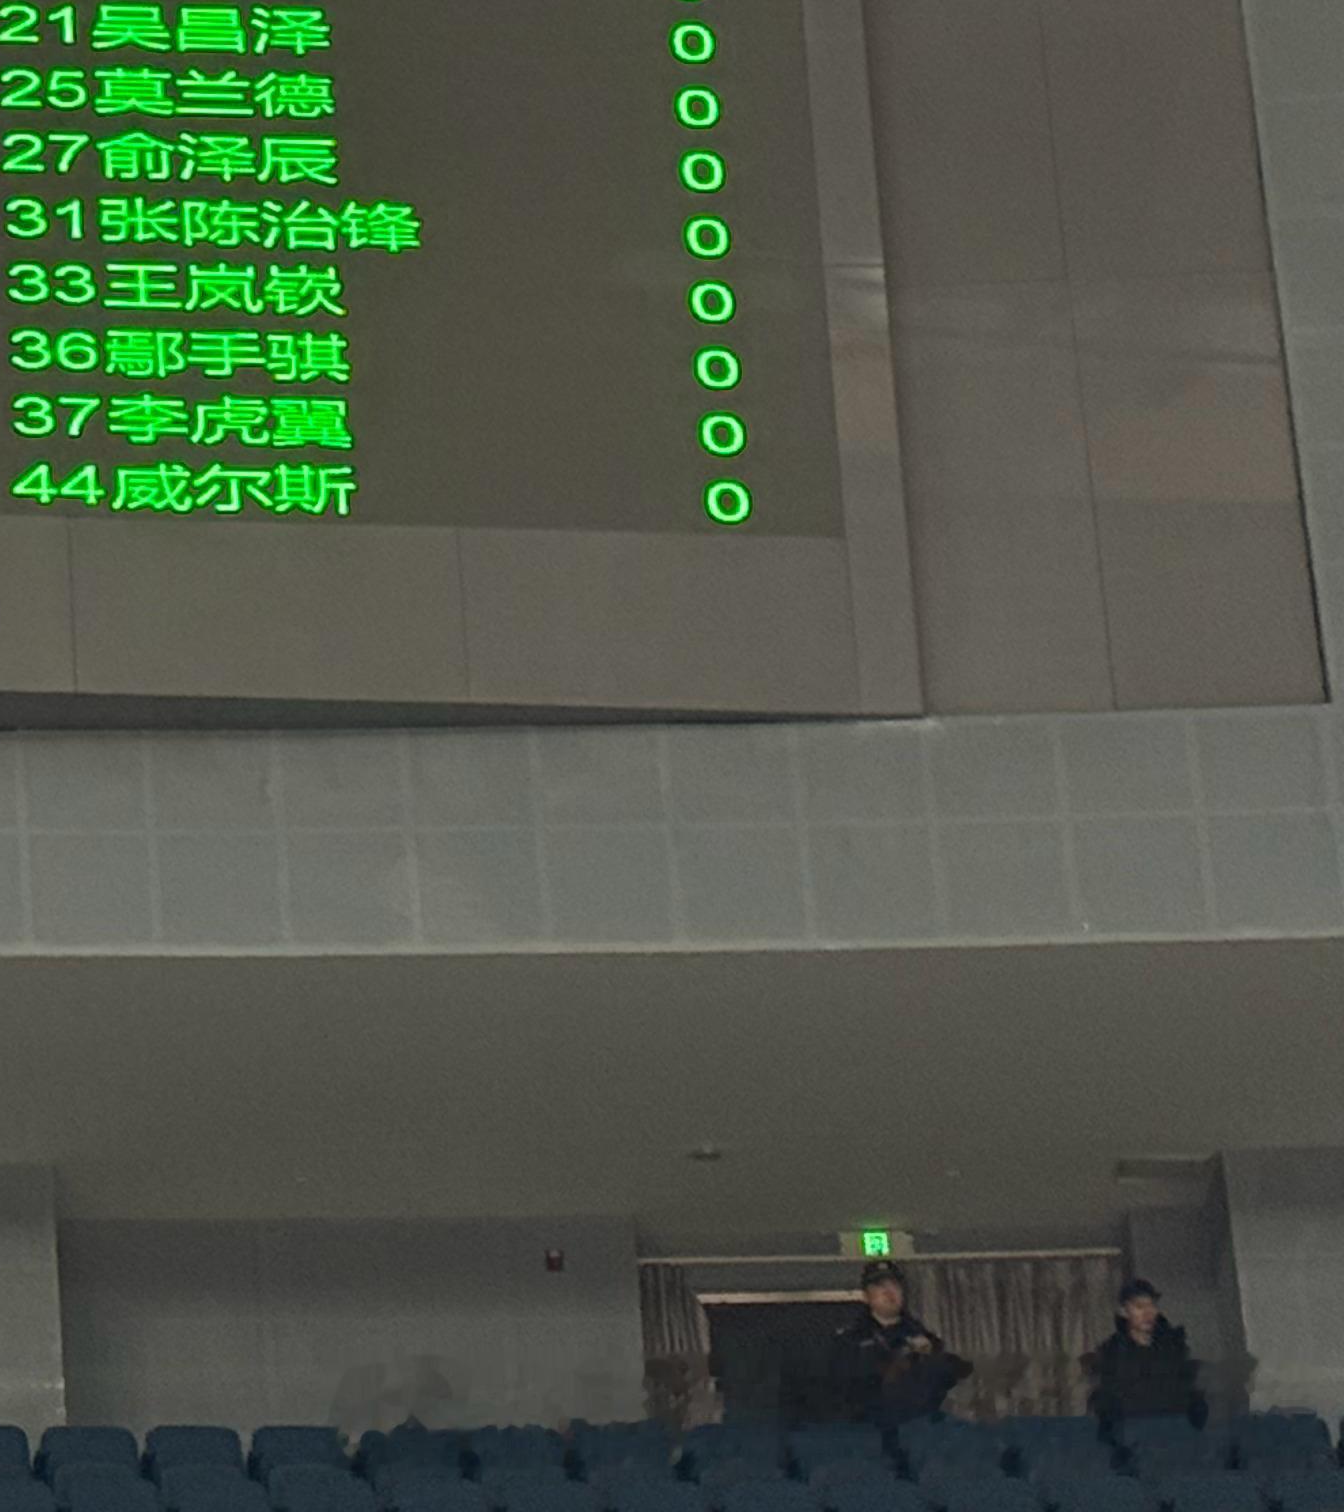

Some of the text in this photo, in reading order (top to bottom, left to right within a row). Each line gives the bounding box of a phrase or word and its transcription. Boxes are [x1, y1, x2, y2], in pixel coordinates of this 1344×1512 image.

[670, 21, 715, 63] 0
[674, 86, 720, 128] 0
[679, 149, 724, 192] 0
[683, 214, 730, 260] 0
[689, 280, 735, 322] 0
[694, 345, 740, 389] 0
[698, 411, 745, 456] 0
[704, 479, 751, 523] 0
